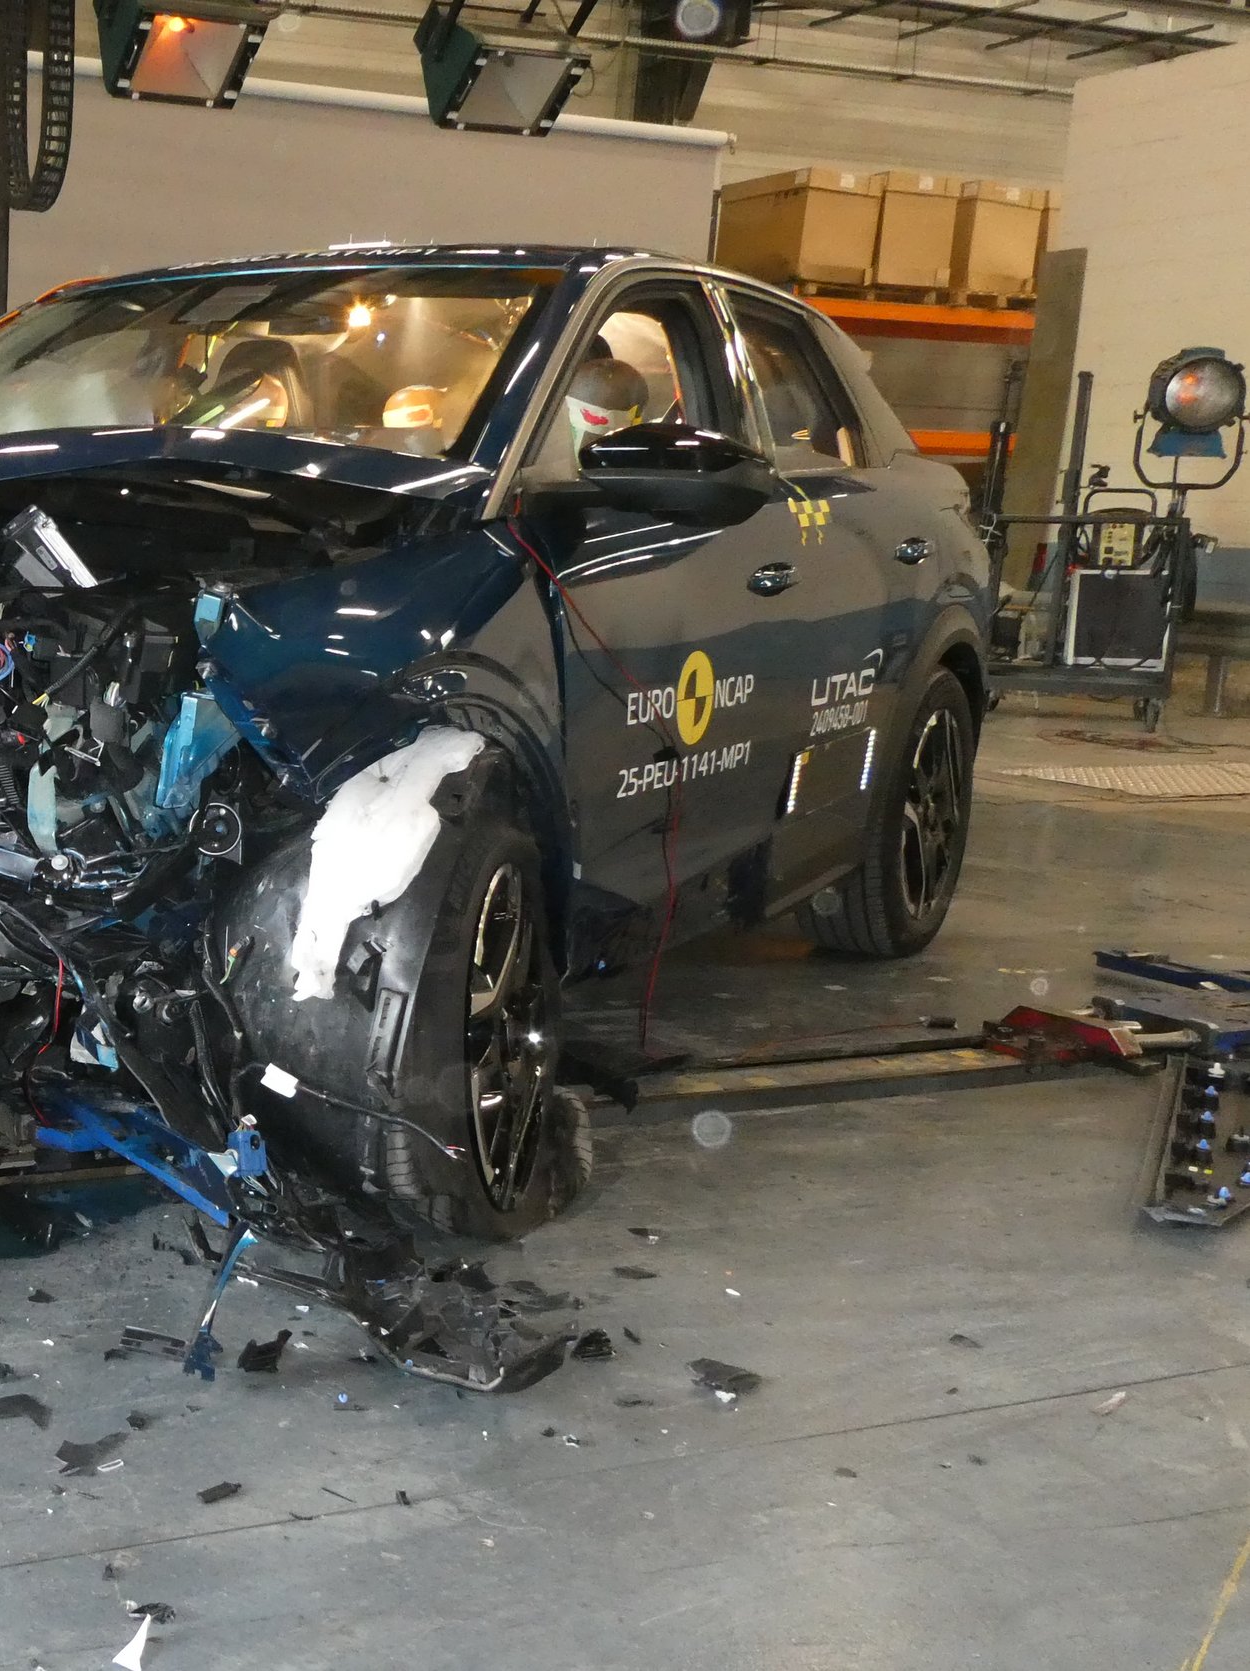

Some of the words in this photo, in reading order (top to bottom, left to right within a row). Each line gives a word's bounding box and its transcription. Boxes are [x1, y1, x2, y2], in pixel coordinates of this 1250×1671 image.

[167, 248, 439, 271] U-1141-MP1
[627, 686, 675, 726] EURO
[714, 674, 755, 709] NCAP
[811, 668, 876, 707] UTAC
[616, 740, 751, 799] 25-PEU-1141-MP1
